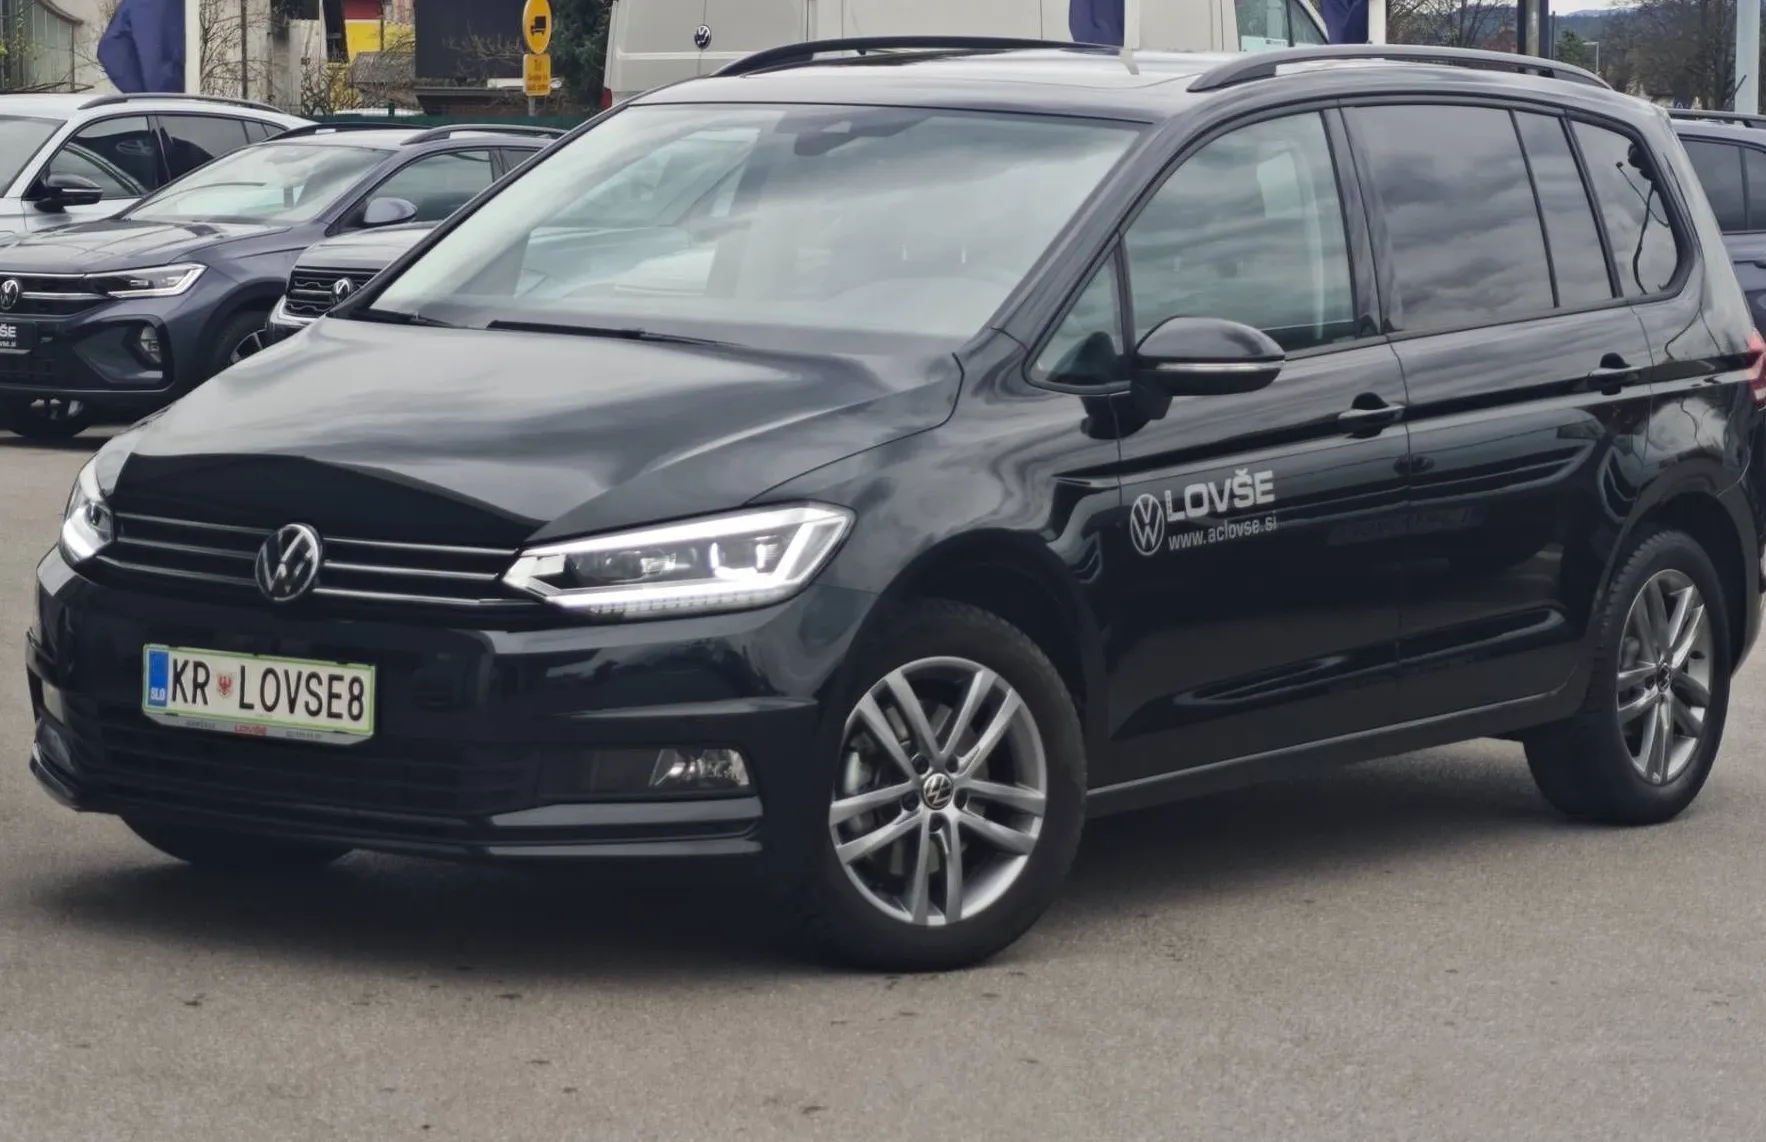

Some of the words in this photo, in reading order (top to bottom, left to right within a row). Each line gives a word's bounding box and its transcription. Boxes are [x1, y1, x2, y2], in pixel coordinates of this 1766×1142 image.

[1164, 467, 1276, 522] LOVŠE
[1168, 510, 1278, 551] www.aclovse.si
[150, 687, 166, 701] SLO
[170, 658, 211, 706] KR
[238, 664, 365, 722] LOVSE8
